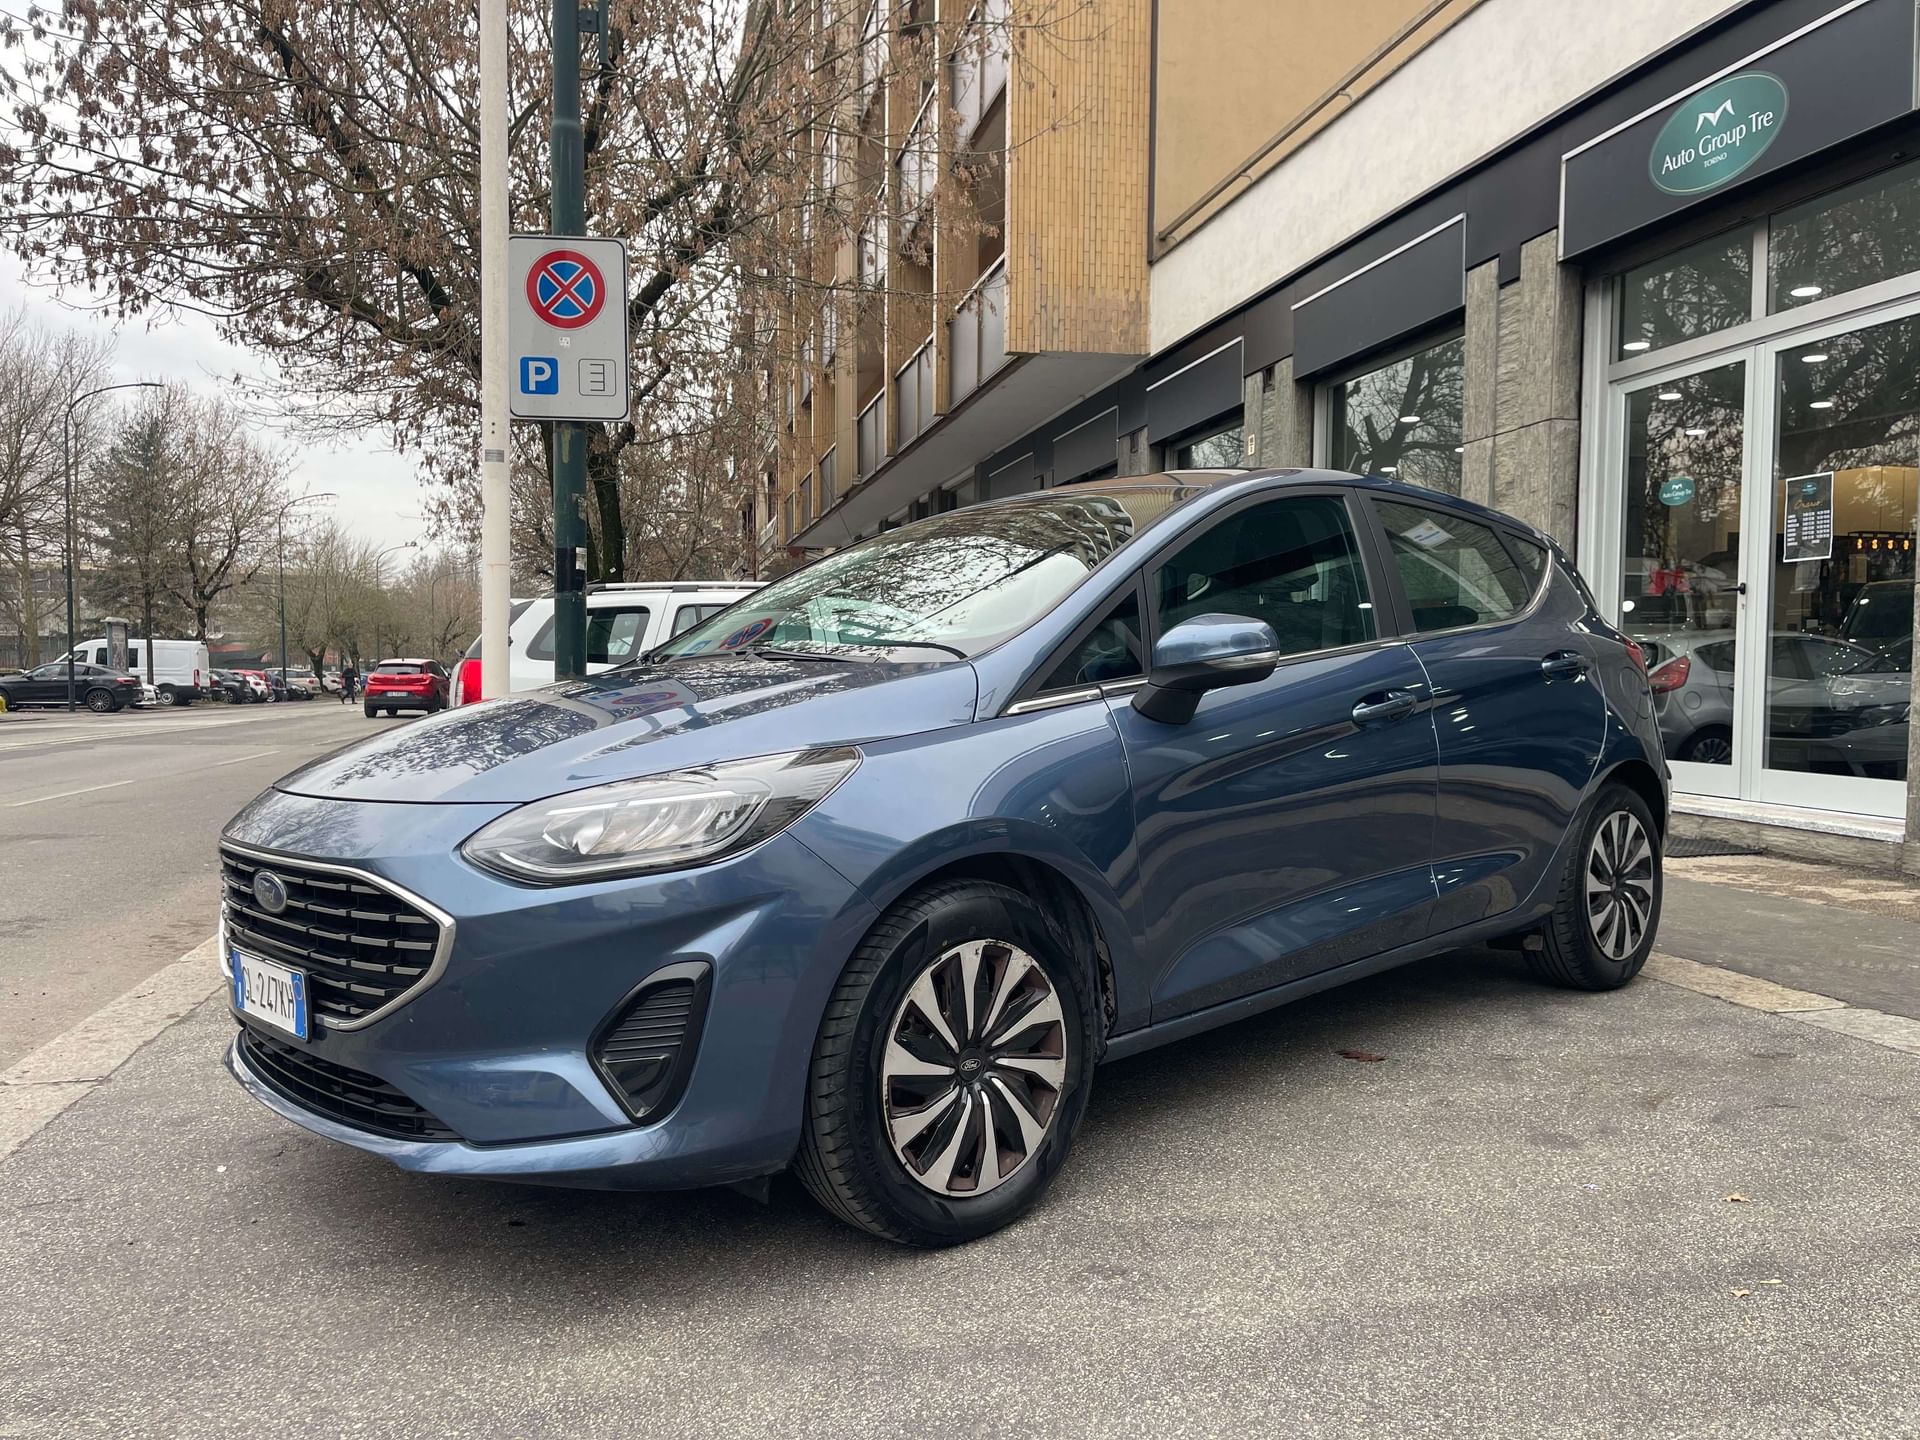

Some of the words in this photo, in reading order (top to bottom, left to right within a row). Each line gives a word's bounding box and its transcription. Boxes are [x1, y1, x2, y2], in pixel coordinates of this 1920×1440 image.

[1661, 148, 1695, 175] Auto
[1698, 124, 1746, 156] Group
[1748, 111, 1773, 133] Tre
[1703, 152, 1727, 168] TORINO
[528, 361, 552, 391] P
[962, 1059, 980, 1070] Ford
